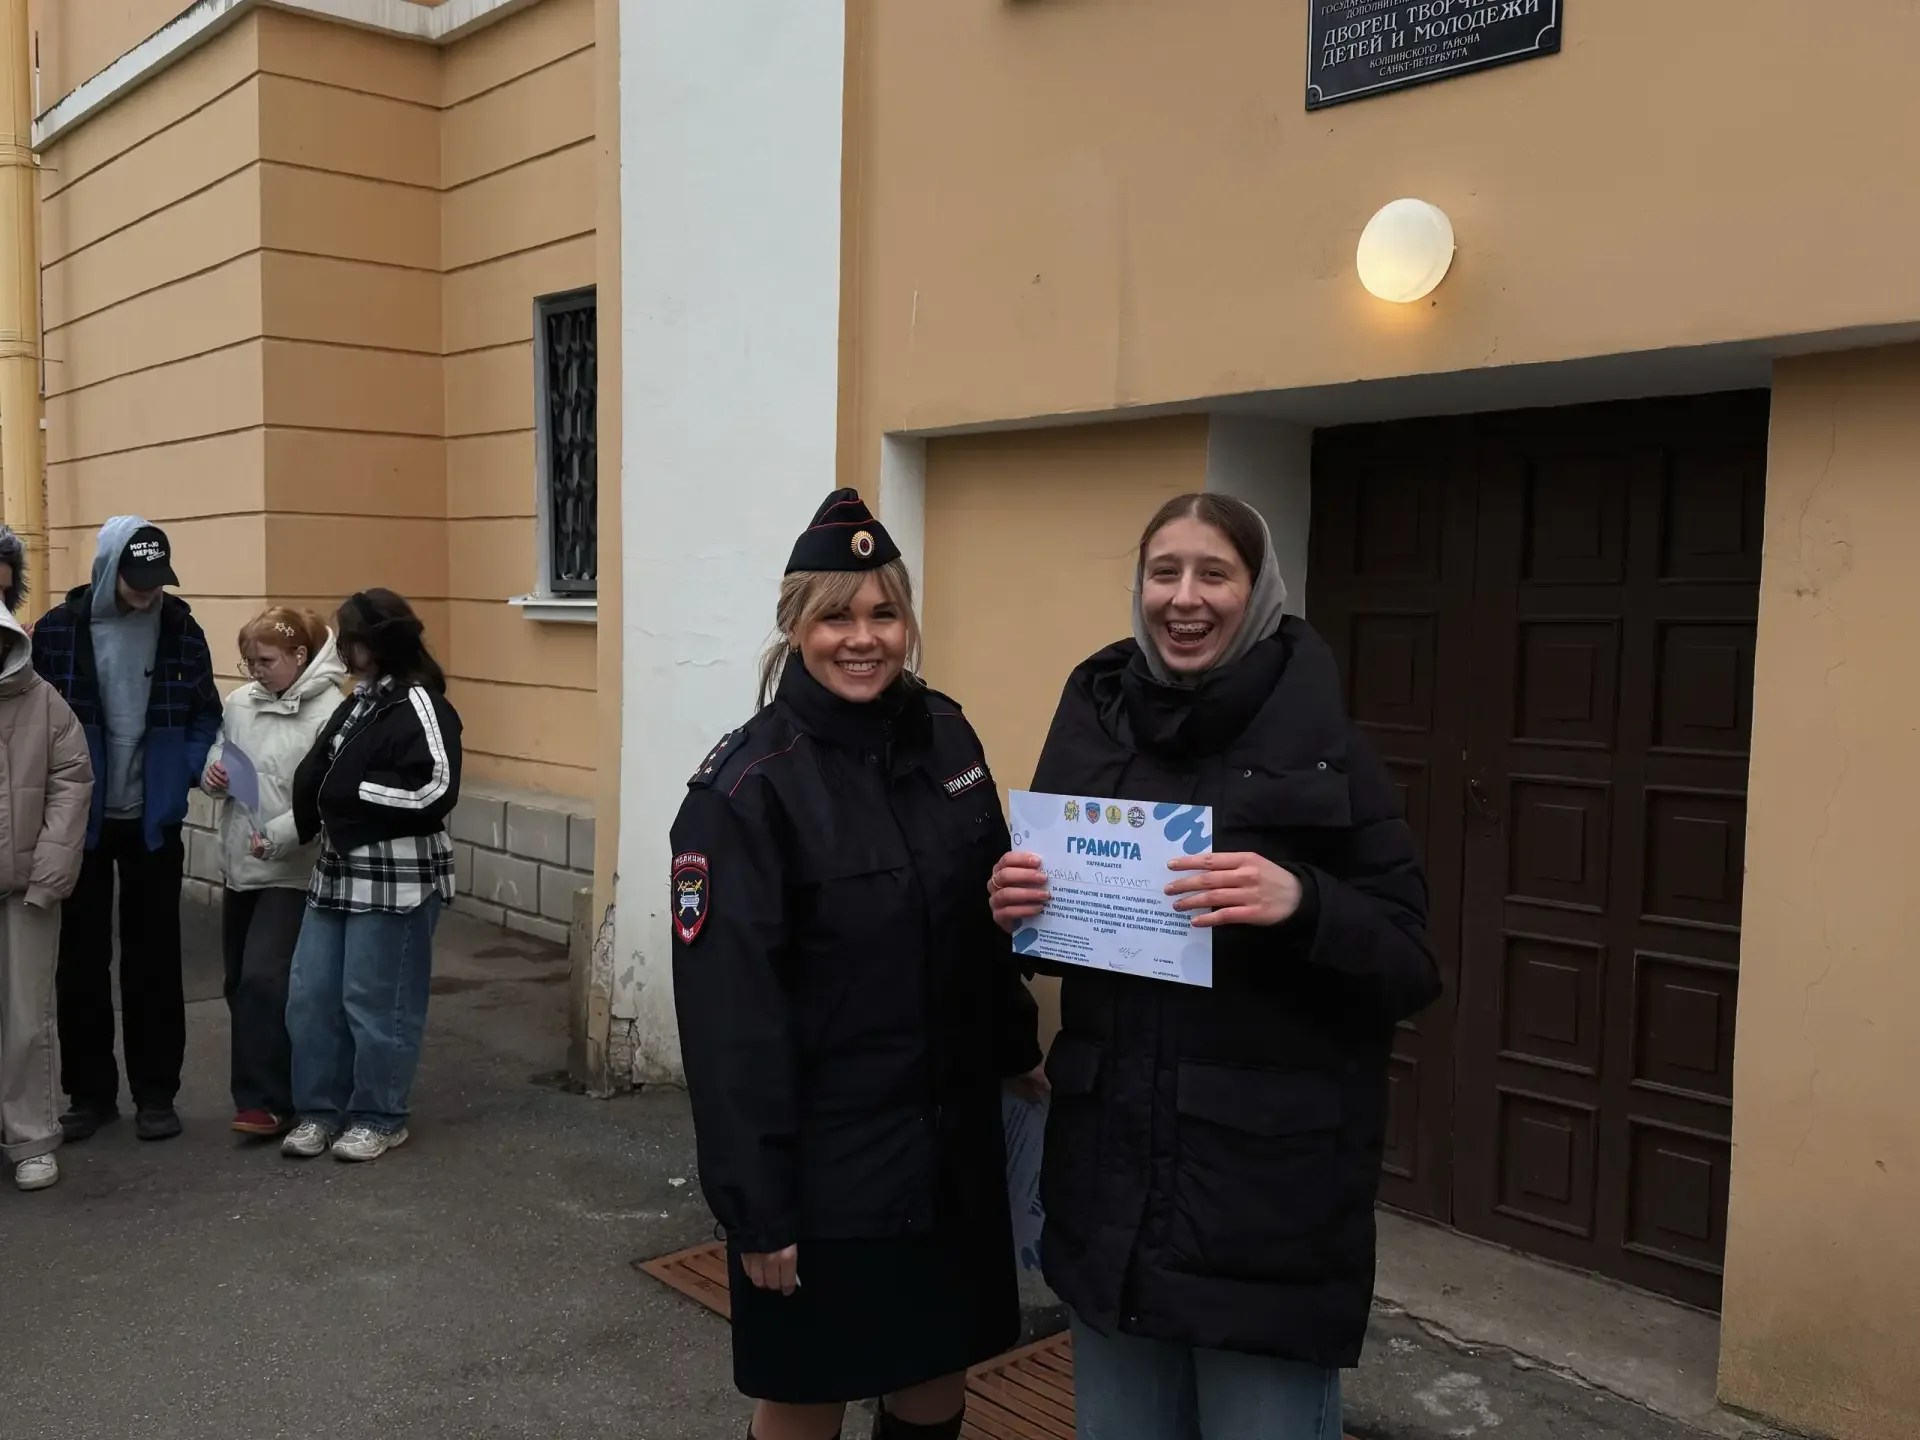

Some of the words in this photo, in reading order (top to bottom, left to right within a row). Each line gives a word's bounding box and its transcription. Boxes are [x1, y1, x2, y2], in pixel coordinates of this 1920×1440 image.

[1321, 34, 1382, 71] ДЕТЕЙ
[1391, 30, 1404, 48] И
[1414, 0, 1539, 42] МОЛОДЕЖИ
[1322, 12, 1398, 51] ДВОРЕЦ
[1369, 44, 1437, 68] КОЛПИНСКОГО
[1442, 33, 1480, 50] РАЙОНА
[1379, 47, 1468, 76] САНКТ-ПЕТЕРБУРГА
[675, 855, 705, 866] ПОЛИЦИЯ
[1067, 836, 1142, 860] ГРАМОТА
